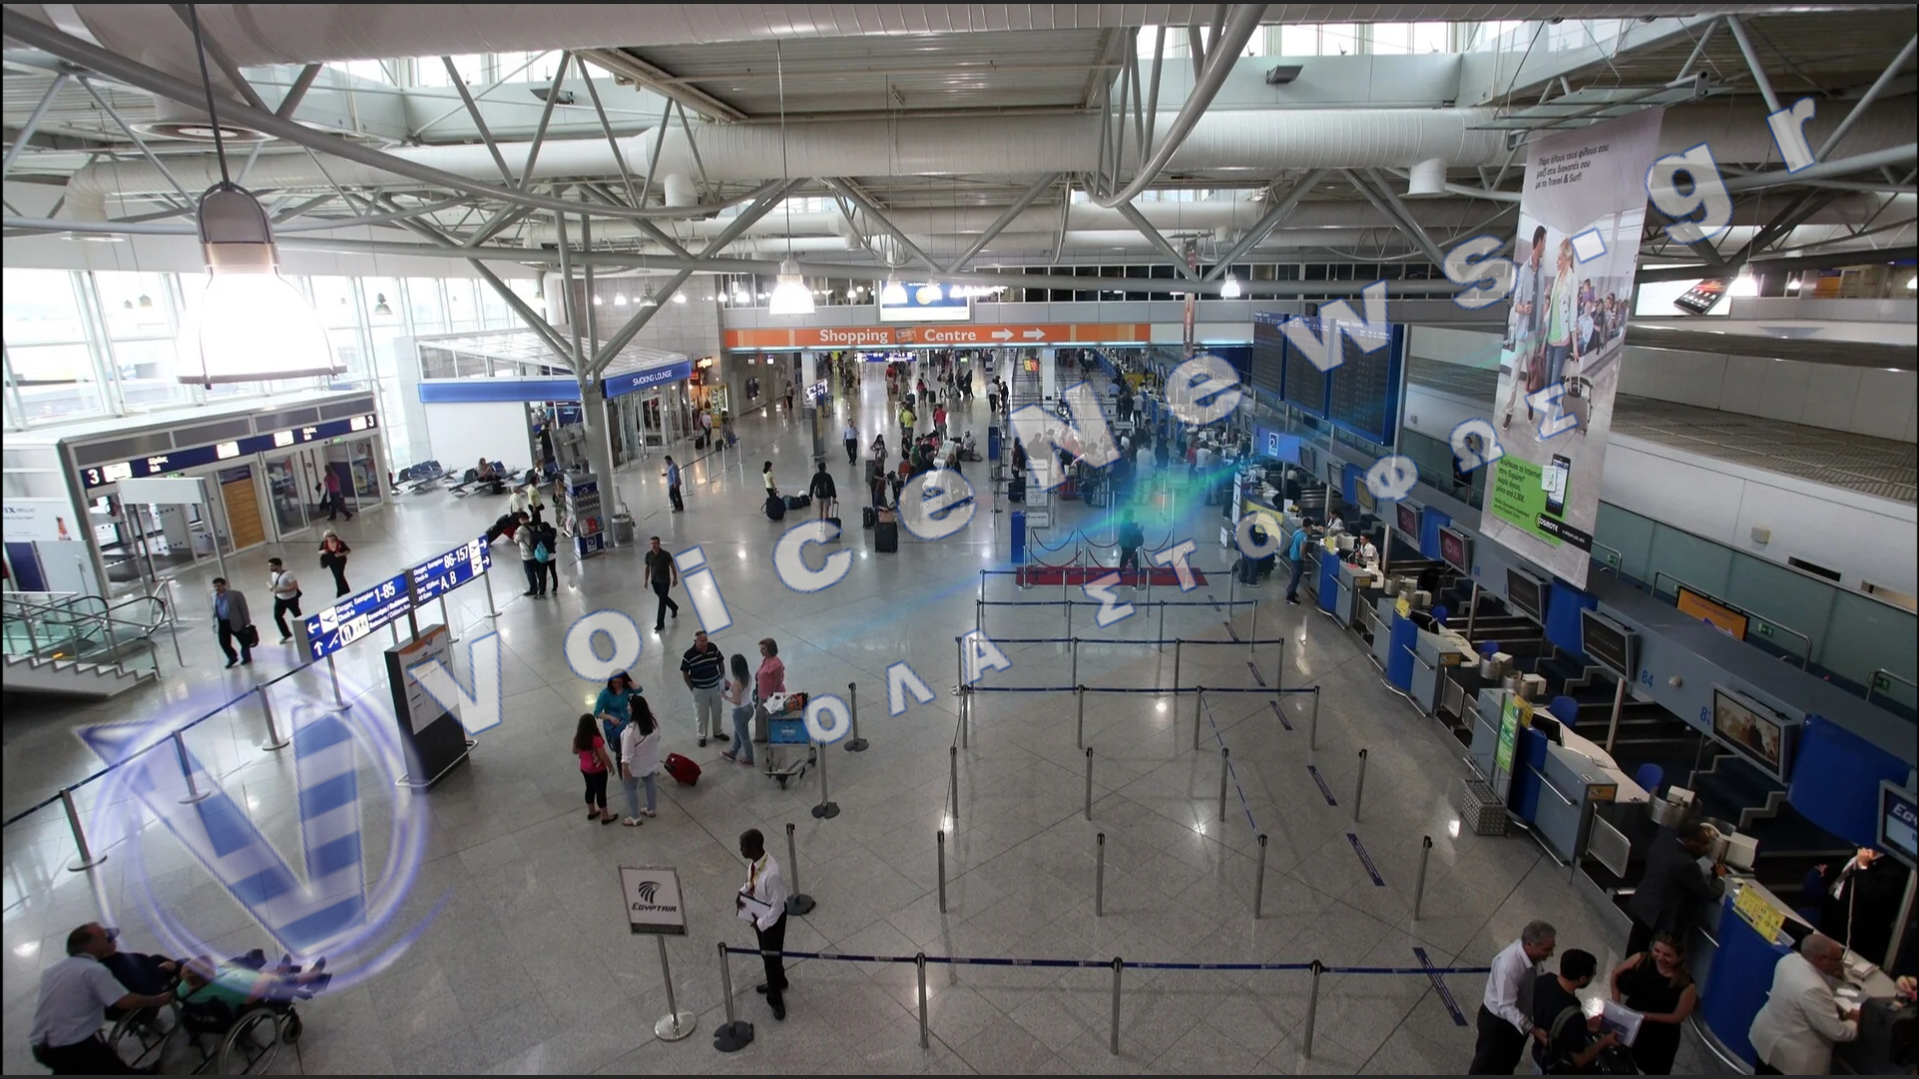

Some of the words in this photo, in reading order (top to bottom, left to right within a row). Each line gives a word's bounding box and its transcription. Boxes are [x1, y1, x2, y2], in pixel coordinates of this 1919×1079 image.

[1548, 175, 1563, 187] Travel
[1563, 173, 1569, 183] &
[820, 329, 888, 344] Shopping
[924, 328, 977, 341] Centre
[632, 373, 655, 386] SMOKING
[654, 369, 673, 381] LOUNGE
[367, 415, 375, 427] 3
[87, 469, 100, 485] 3
[1537, 517, 1559, 533] COSMOTE
[443, 545, 469, 569] 86-157
[449, 571, 457, 585] B
[374, 581, 396, 602] 1-85
[1641, 670, 1654, 688] 84
[631, 902, 677, 912] EGYPTAIR
